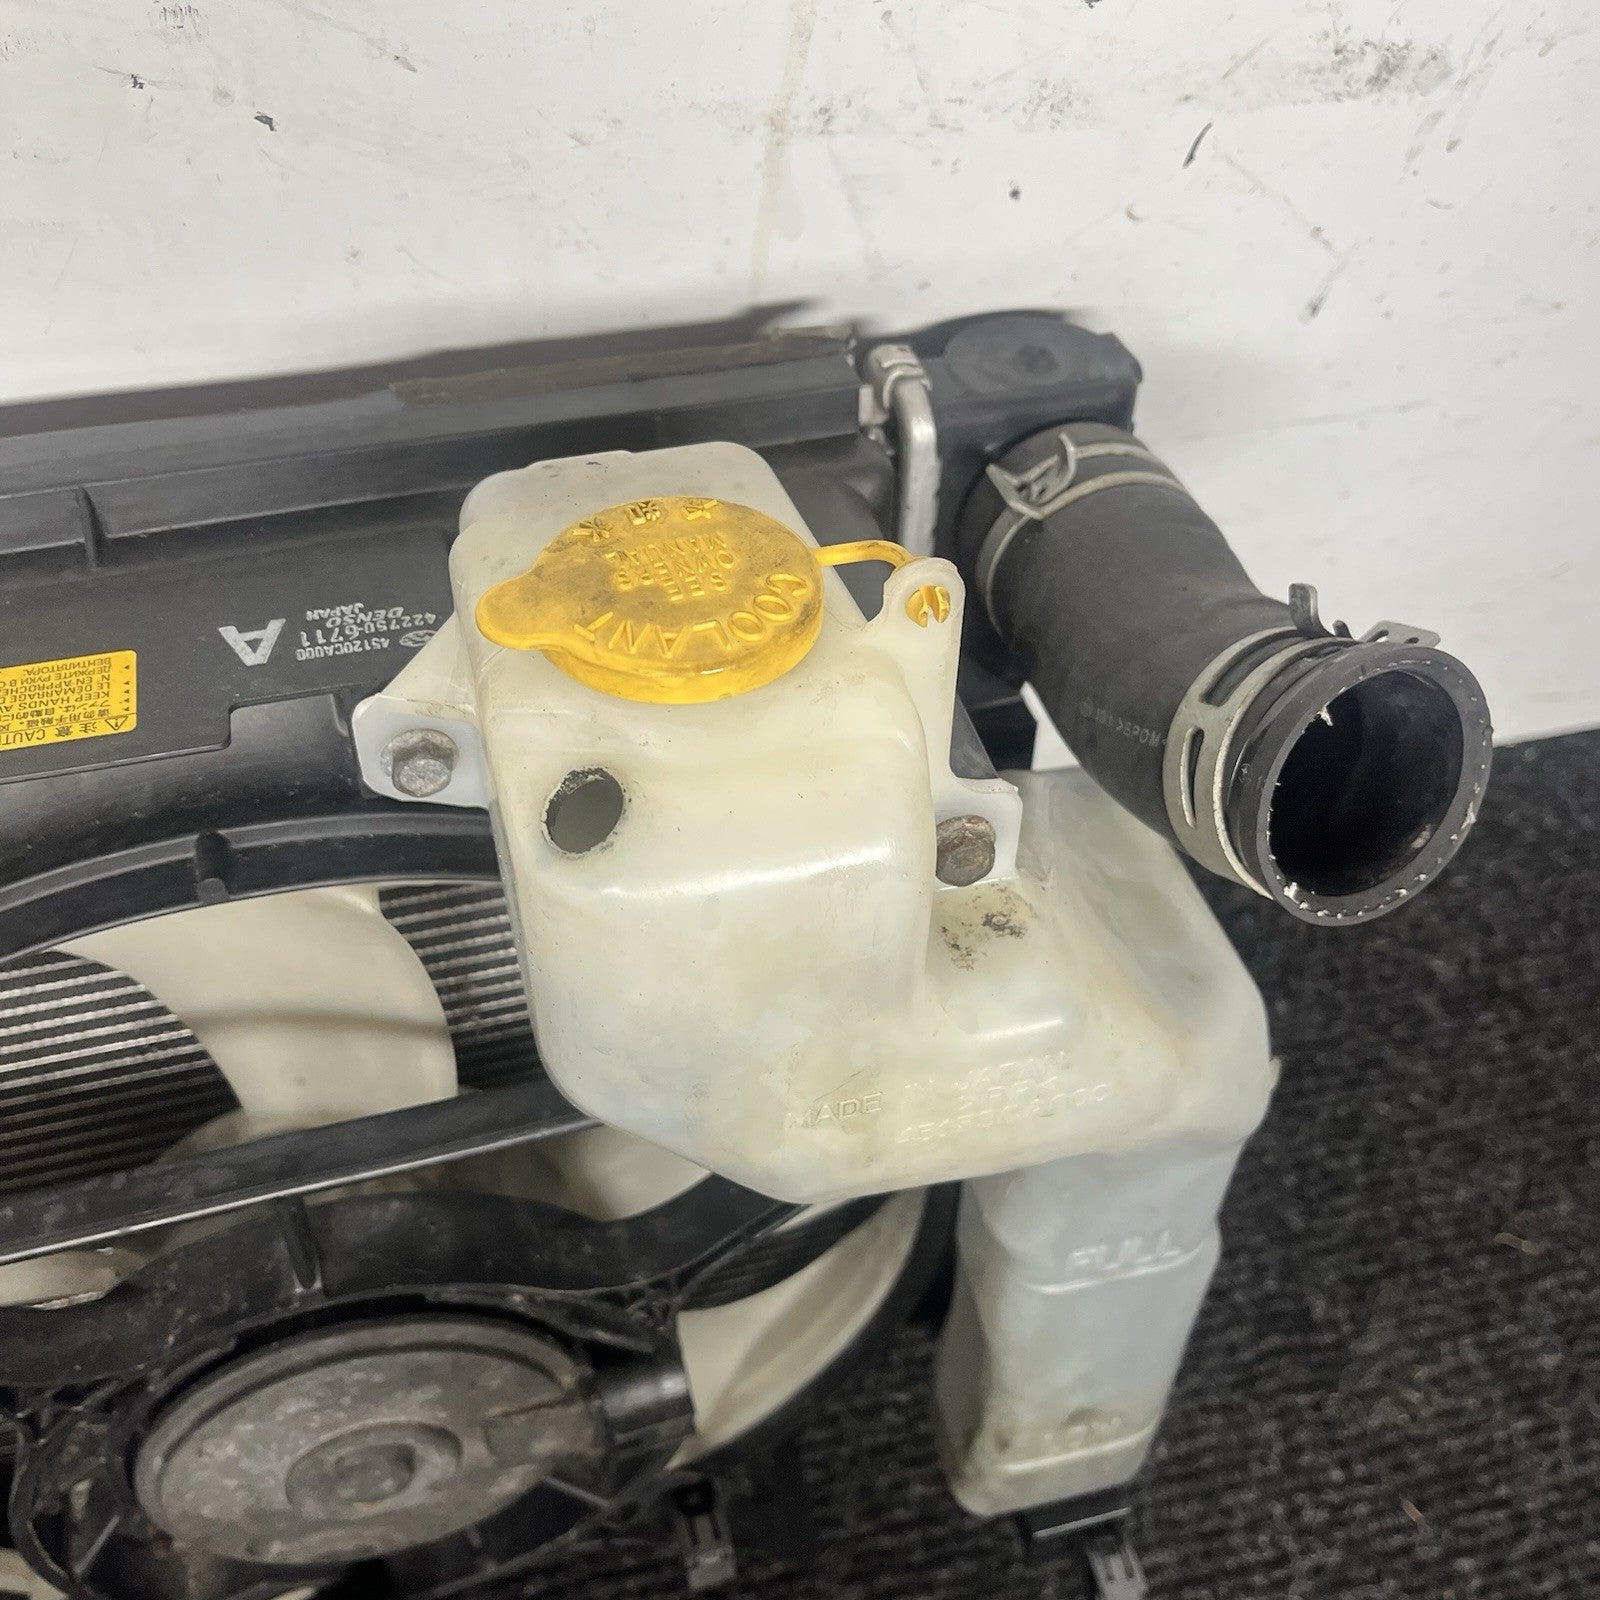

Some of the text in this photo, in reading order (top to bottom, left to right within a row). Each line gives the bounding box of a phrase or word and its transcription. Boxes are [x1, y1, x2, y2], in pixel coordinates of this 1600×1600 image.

[604, 531, 727, 566] MANUAL
[662, 571, 727, 602] SEE
[305, 602, 364, 621] JAPAN
[325, 606, 405, 628] DENSO
[574, 572, 808, 660] COOLANT
[299, 611, 437, 647] 422750-6711
[217, 617, 287, 667] A
[296, 637, 391, 662] 45120CA000
[21, 674, 51, 686] РУКИ
[54, 665, 111, 681] ДЕРЖИТЕ
[0, 679, 72, 696] APPROCHE
[75, 690, 110, 703] KEEP
[97, 681, 111, 691] LE
[0, 699, 111, 722] ファンは、自動的に
[19, 694, 70, 711] HANDS
[55, 722, 97, 738] 注意
[788, 1091, 884, 1129] MADE
[1065, 1230, 1181, 1275] FULL
